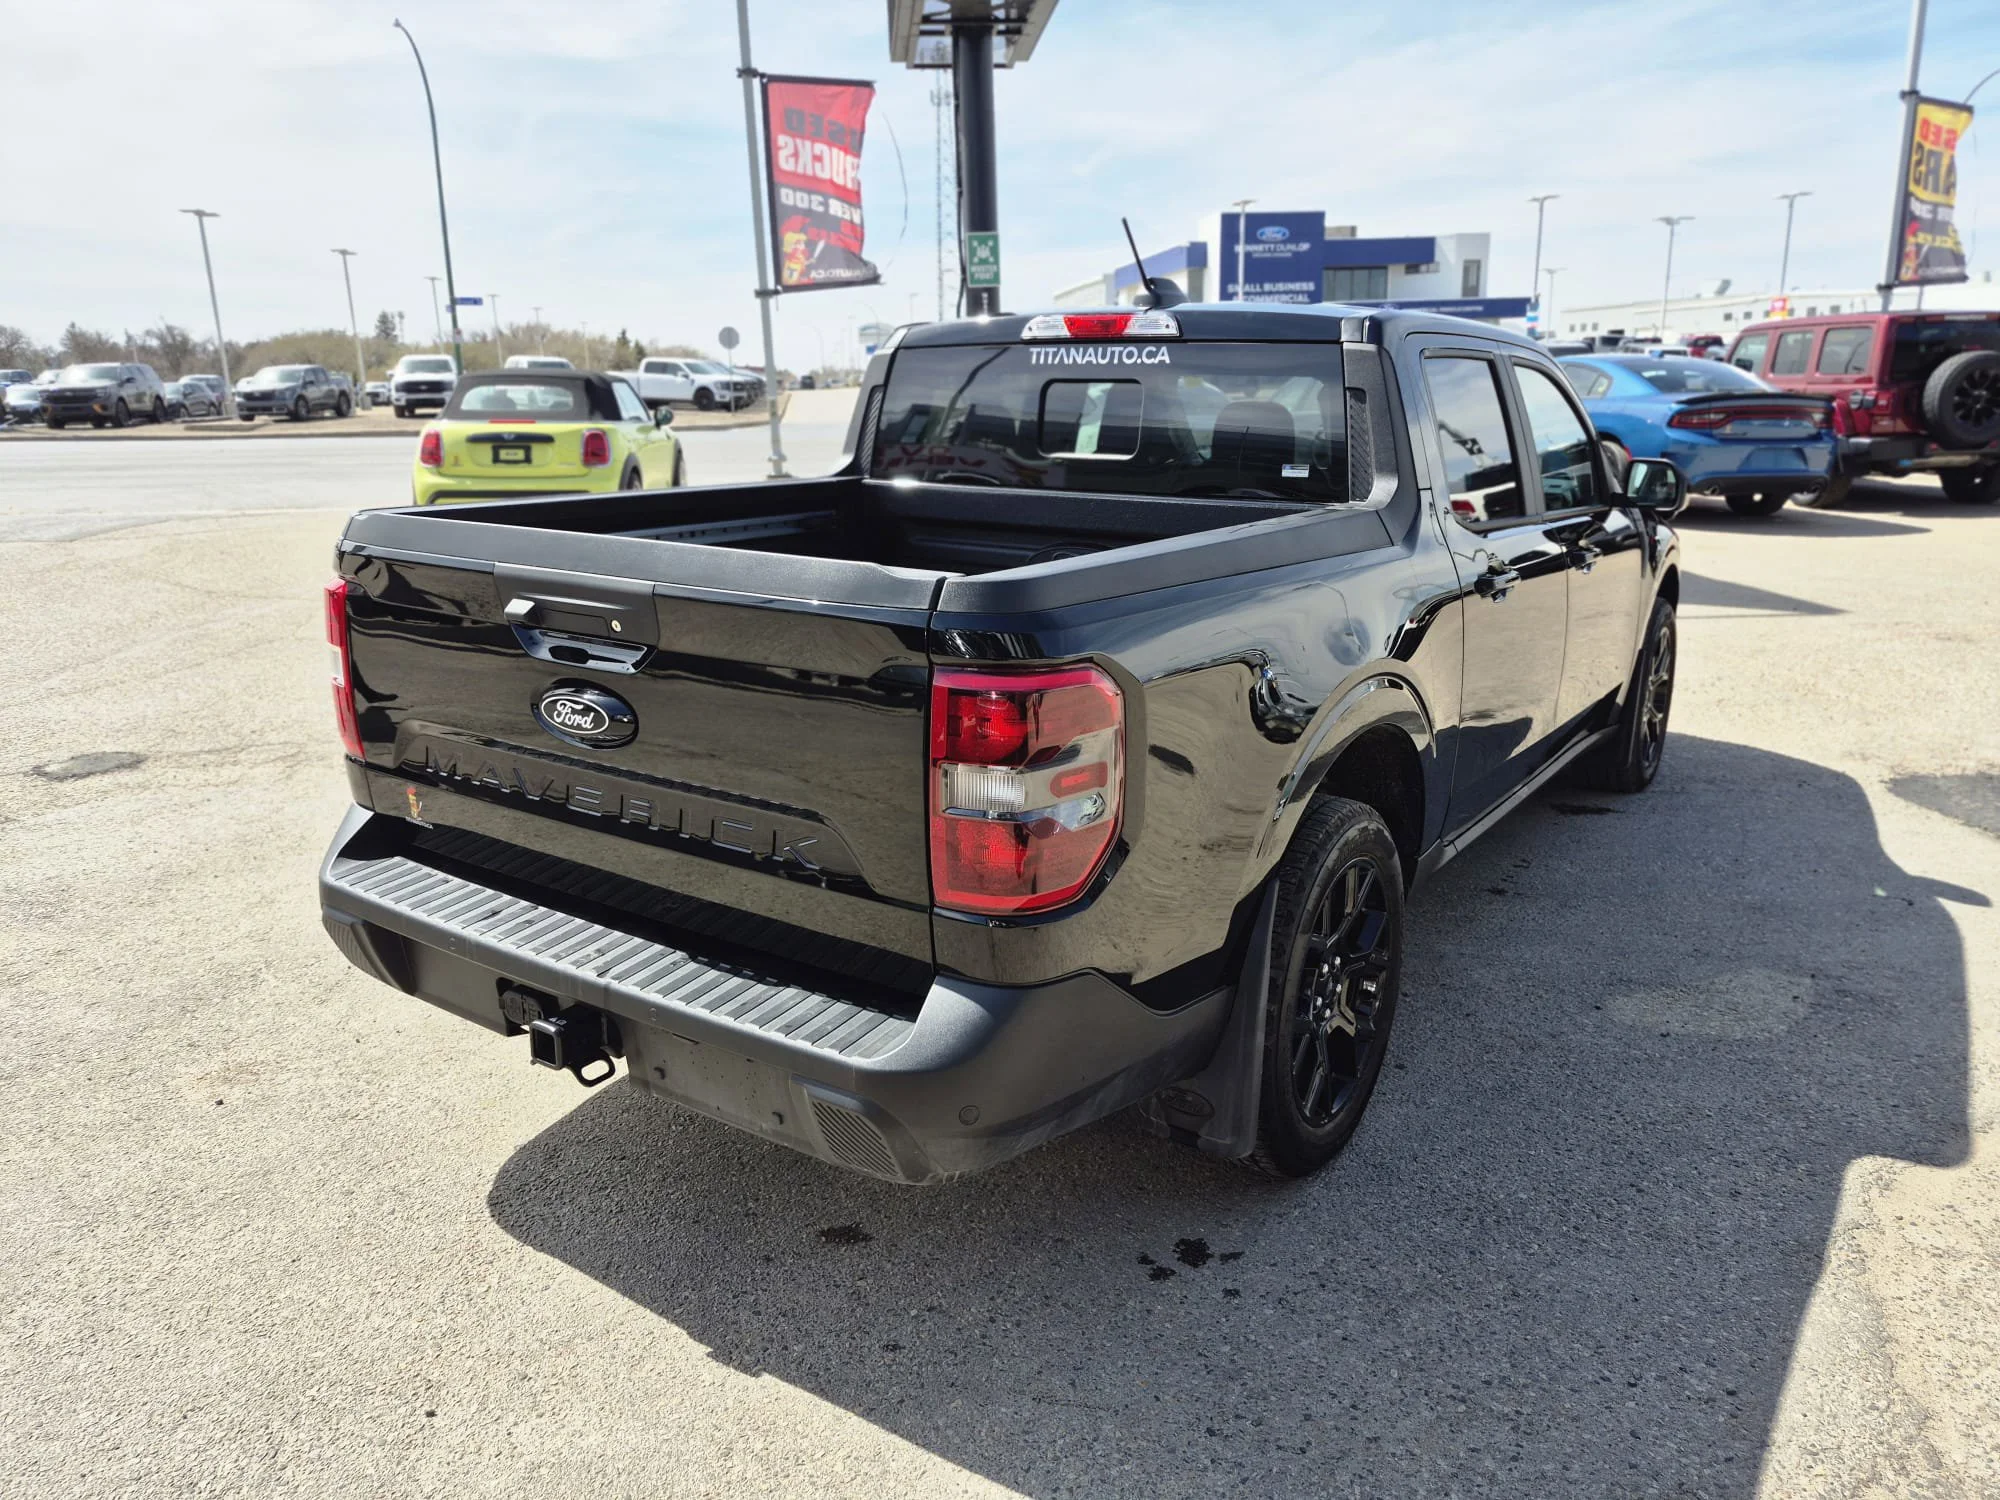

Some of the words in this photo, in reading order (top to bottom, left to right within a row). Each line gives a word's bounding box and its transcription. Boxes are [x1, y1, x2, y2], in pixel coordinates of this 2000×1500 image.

[1029, 346, 1170, 365] TITANAUTO.CA
[553, 700, 595, 729] Ford
[424, 744, 823, 871] MAVERICK
